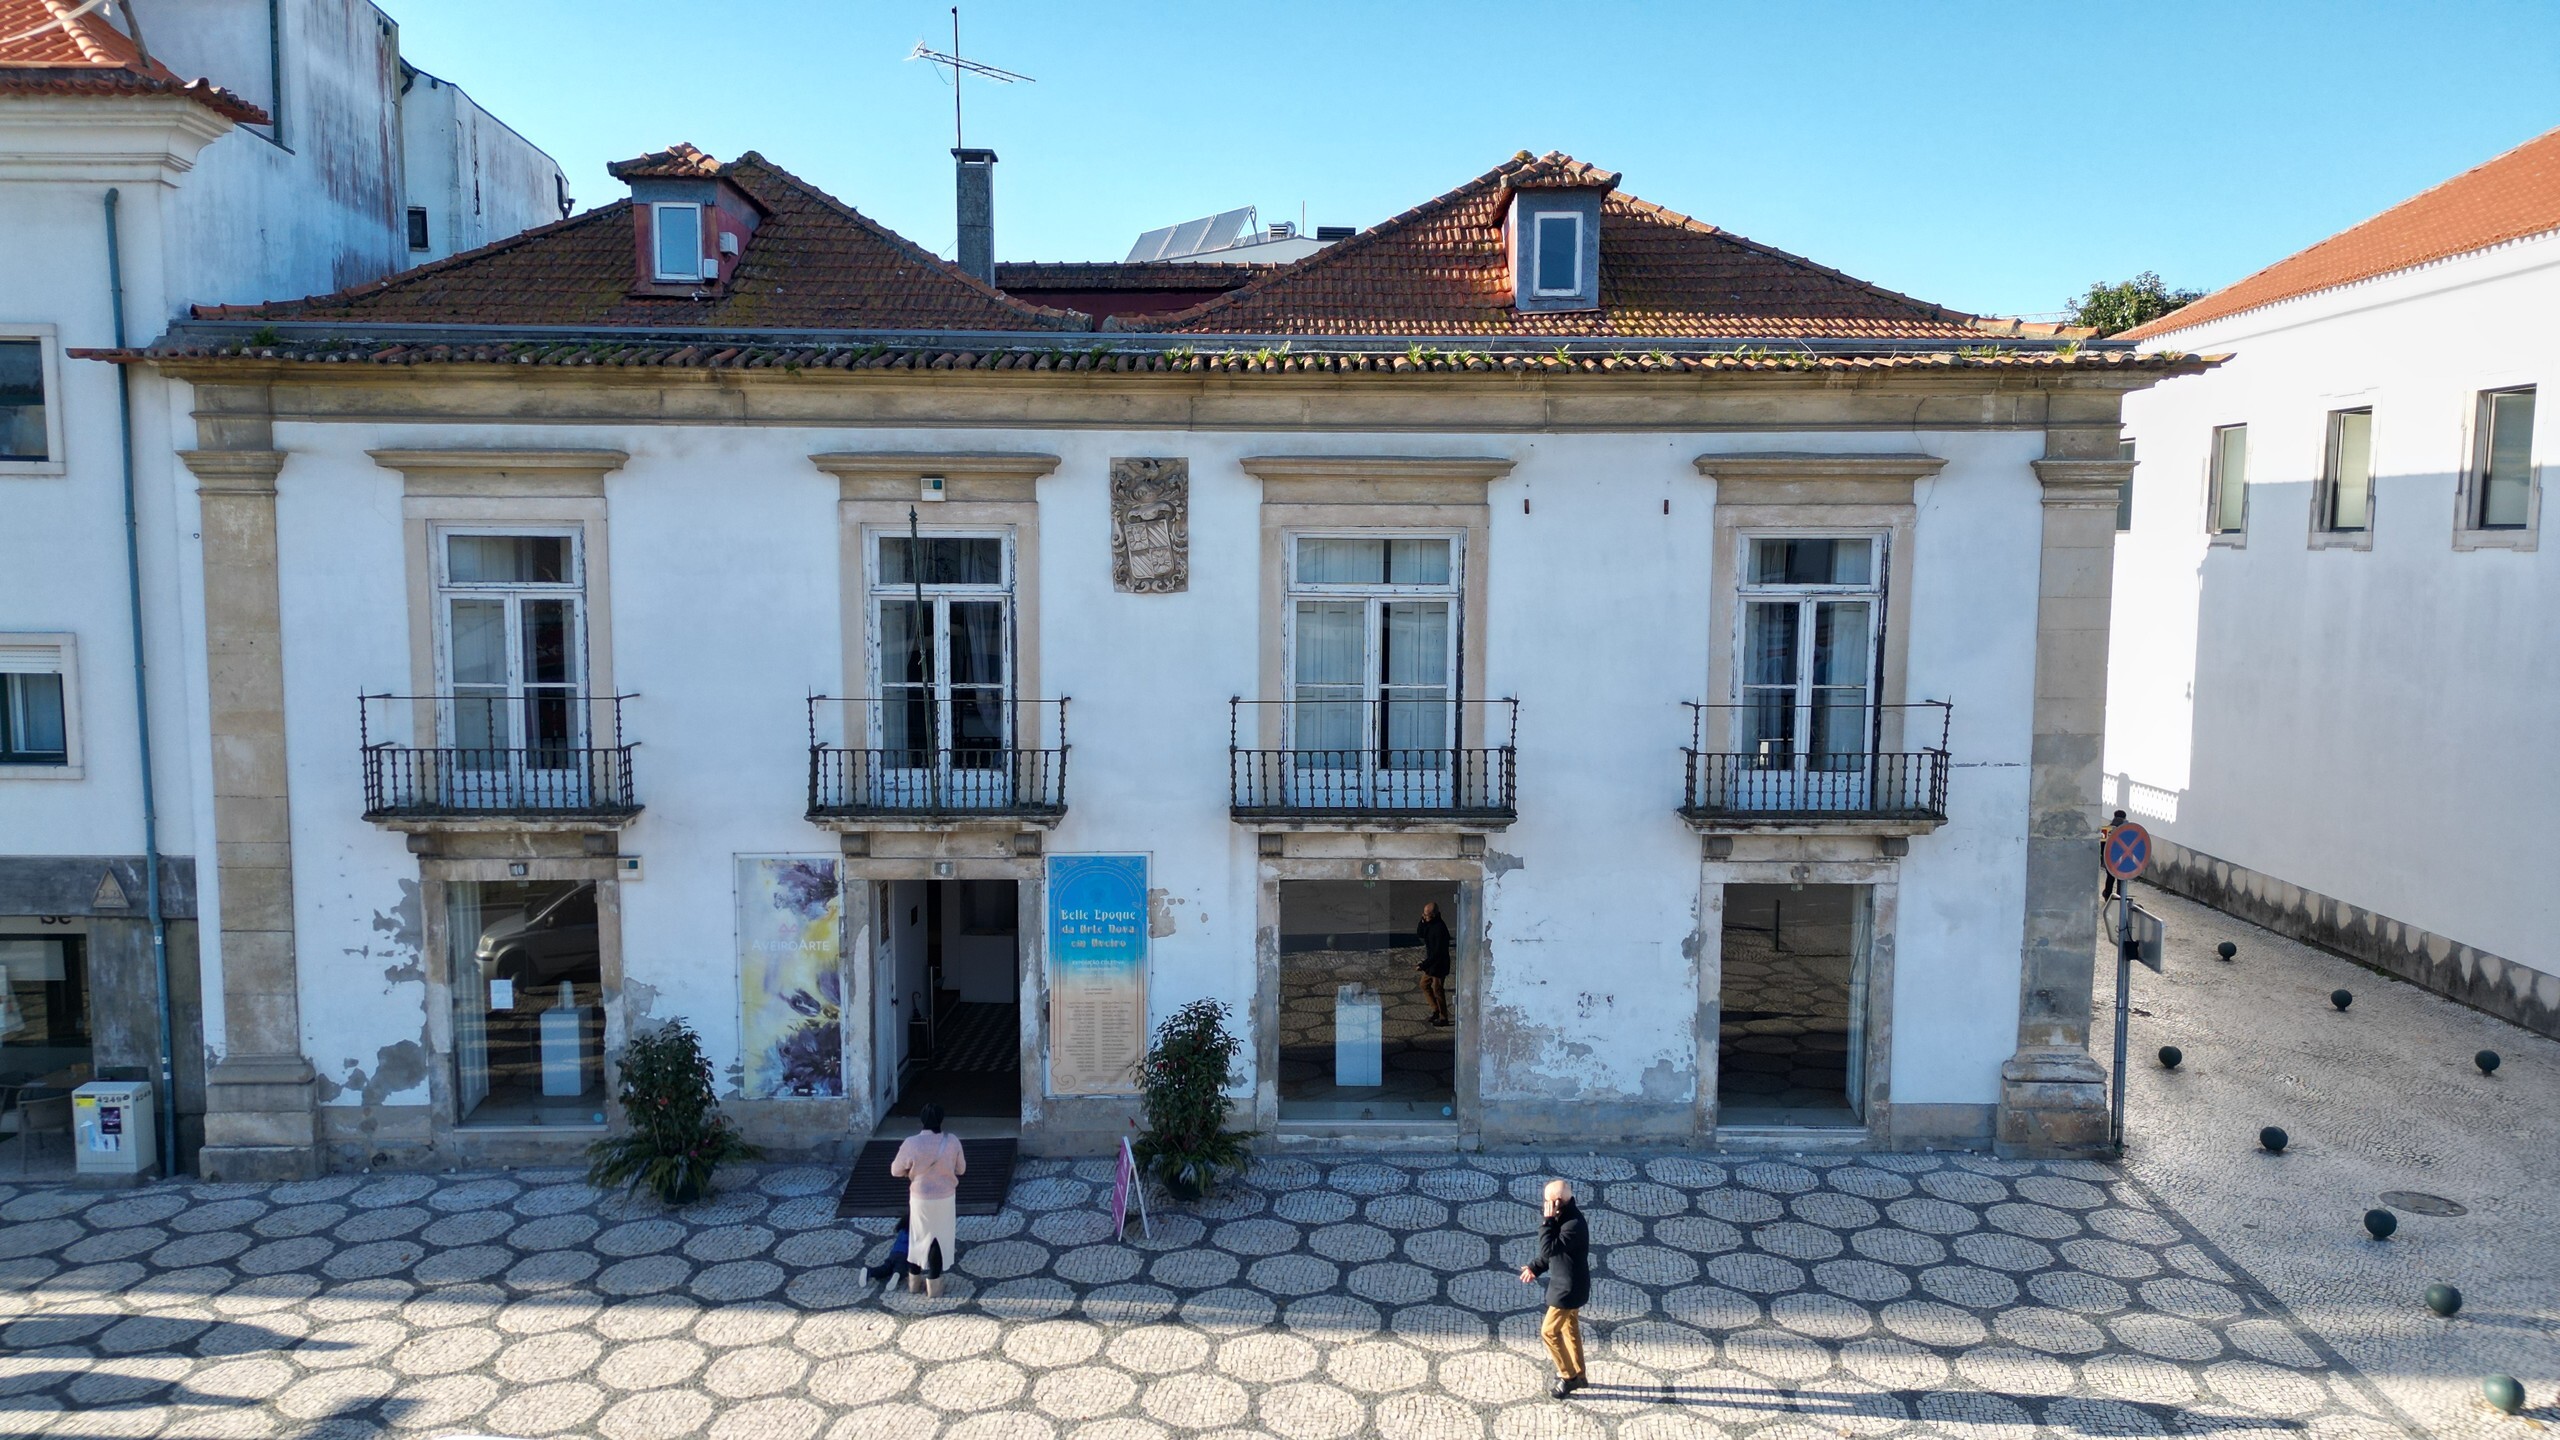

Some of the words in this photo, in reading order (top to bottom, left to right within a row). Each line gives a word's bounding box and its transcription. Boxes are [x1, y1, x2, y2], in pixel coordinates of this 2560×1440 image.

[514, 864, 525, 875] 10
[1061, 909, 1089, 920] Belle
[1062, 924, 1075, 934] da
[1079, 924, 1103, 934] Arte
[1108, 924, 1135, 934] Nova
[1071, 939, 1086, 948] em
[1091, 938, 1127, 948] Aveiro
